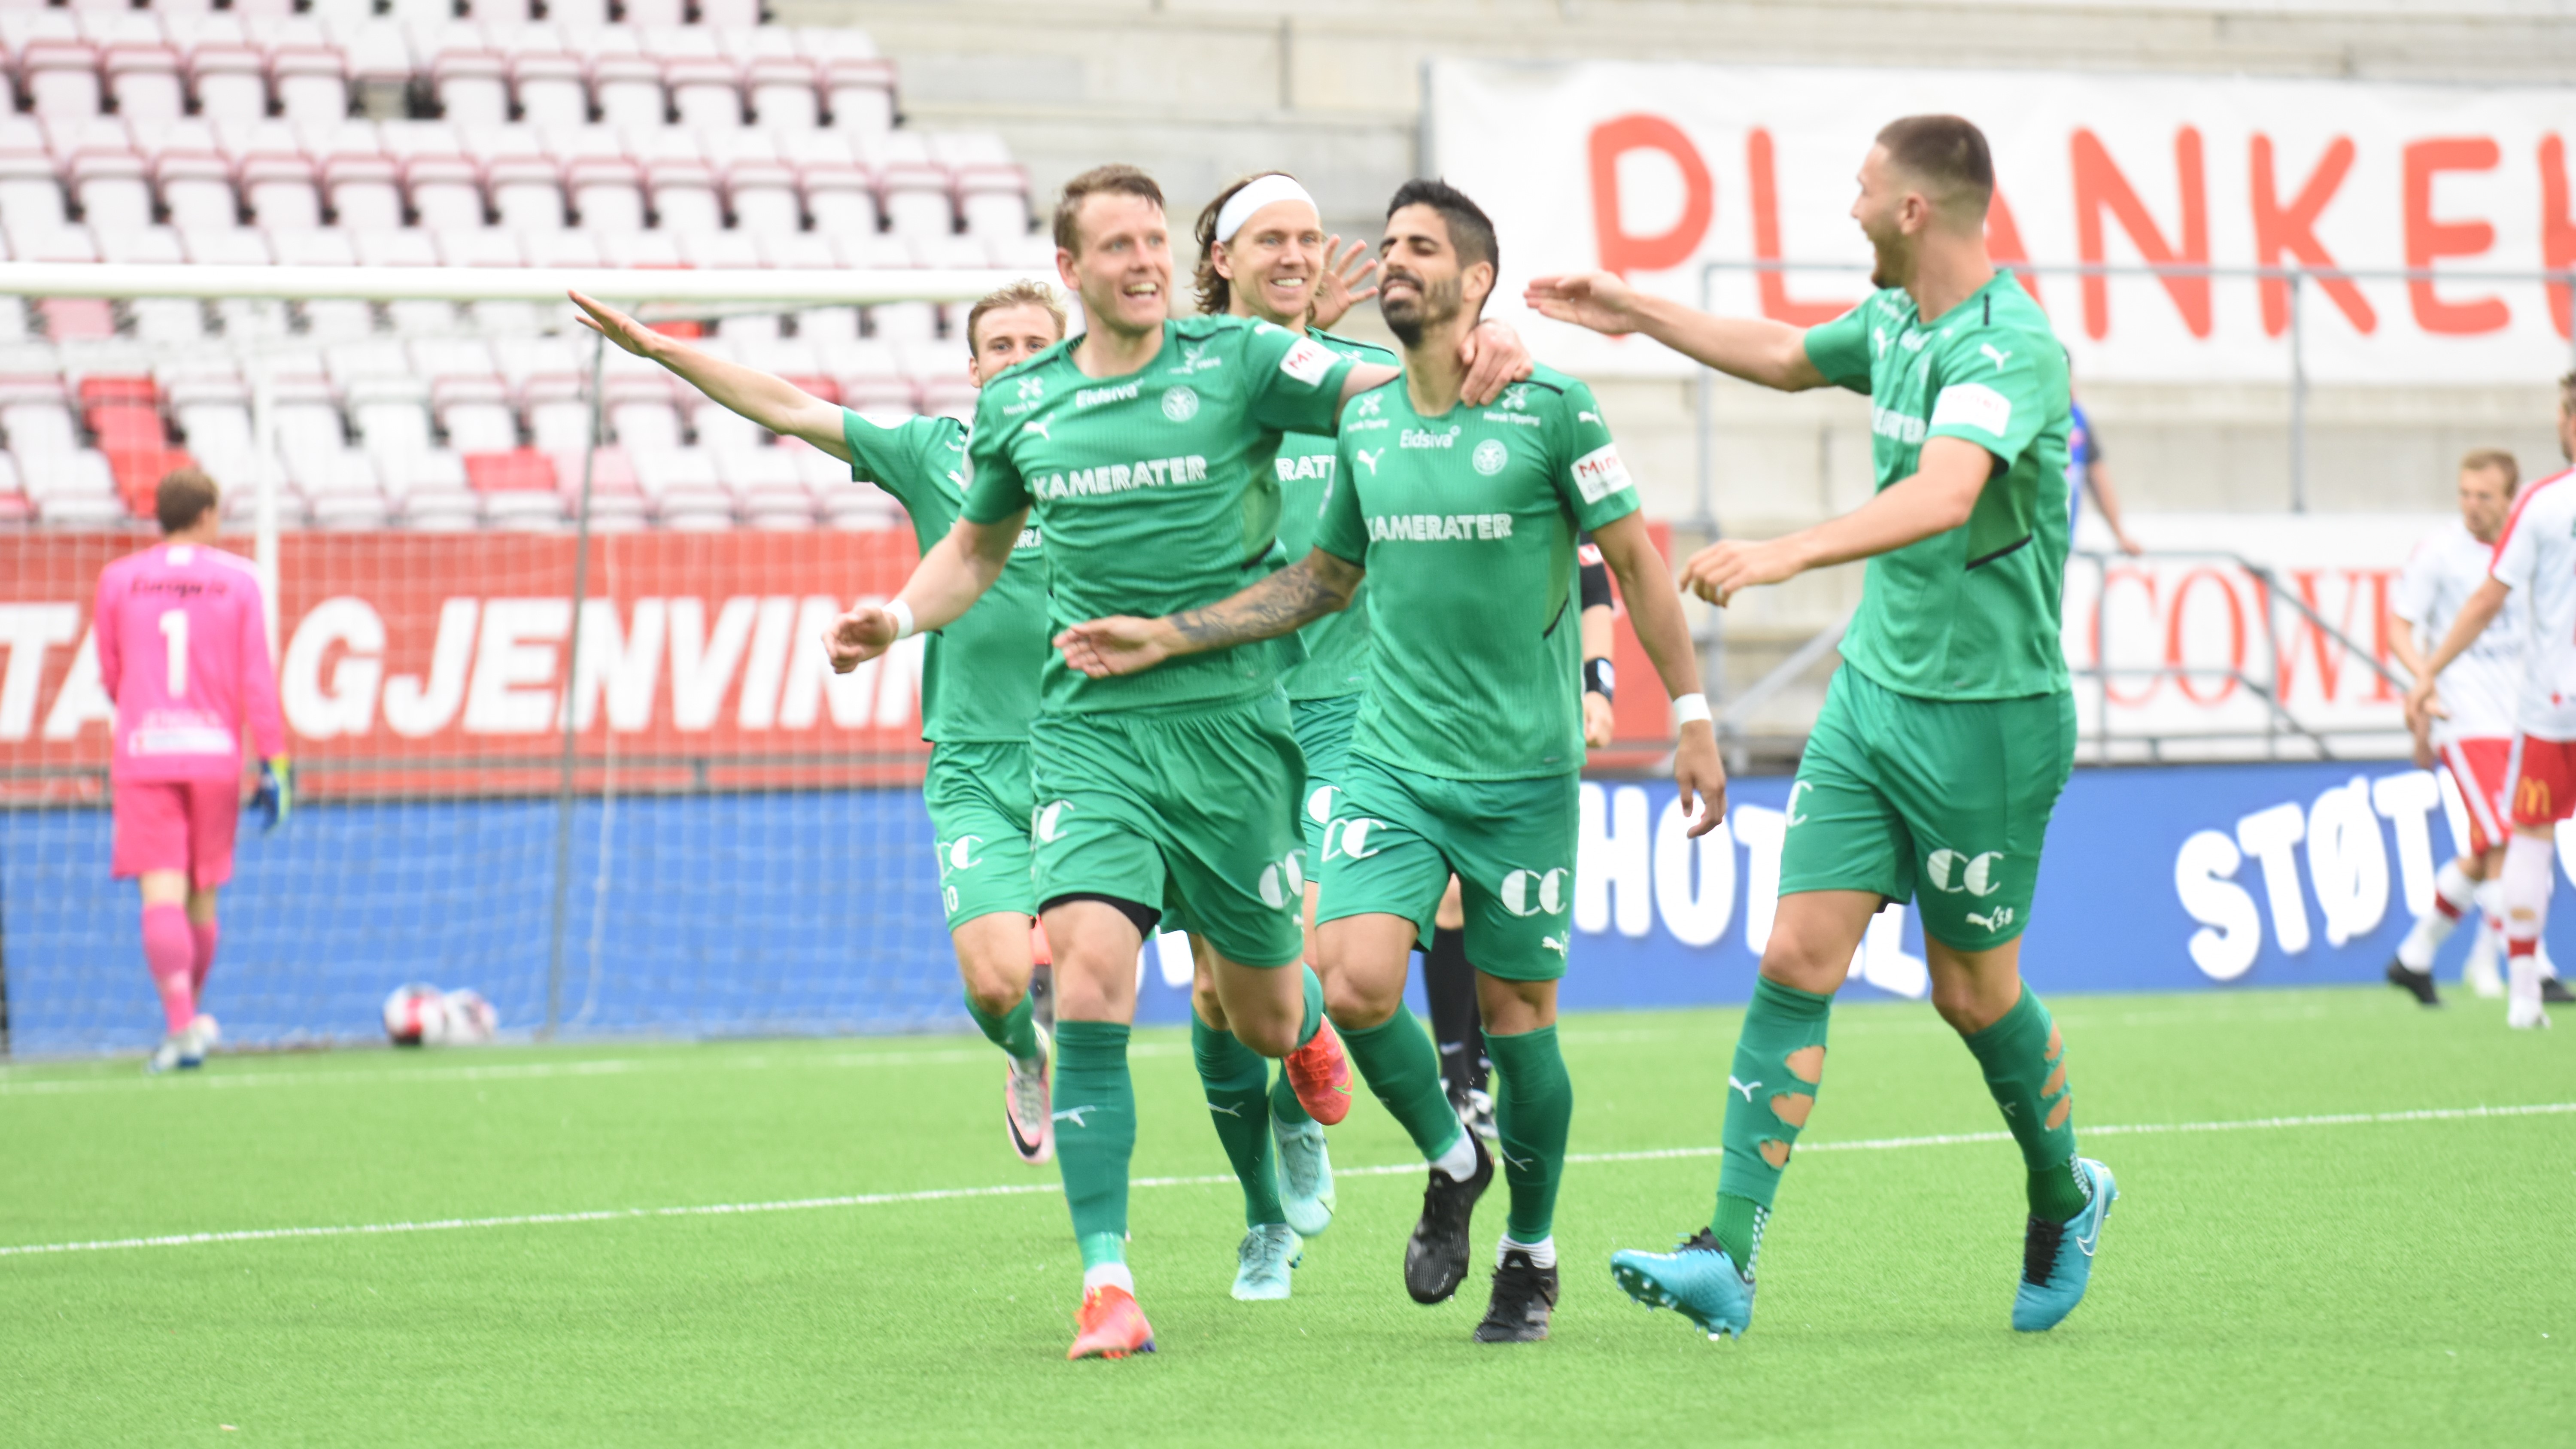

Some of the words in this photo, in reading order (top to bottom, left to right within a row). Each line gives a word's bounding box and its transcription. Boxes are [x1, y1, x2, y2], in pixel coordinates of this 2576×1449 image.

[1032, 455, 1207, 502] KAMERATER
[1400, 428, 1454, 448] Eidsiva
[159, 608, 188, 697] 1
[2088, 566, 2403, 713] COWI
[1572, 781, 1929, 999] HOTL
